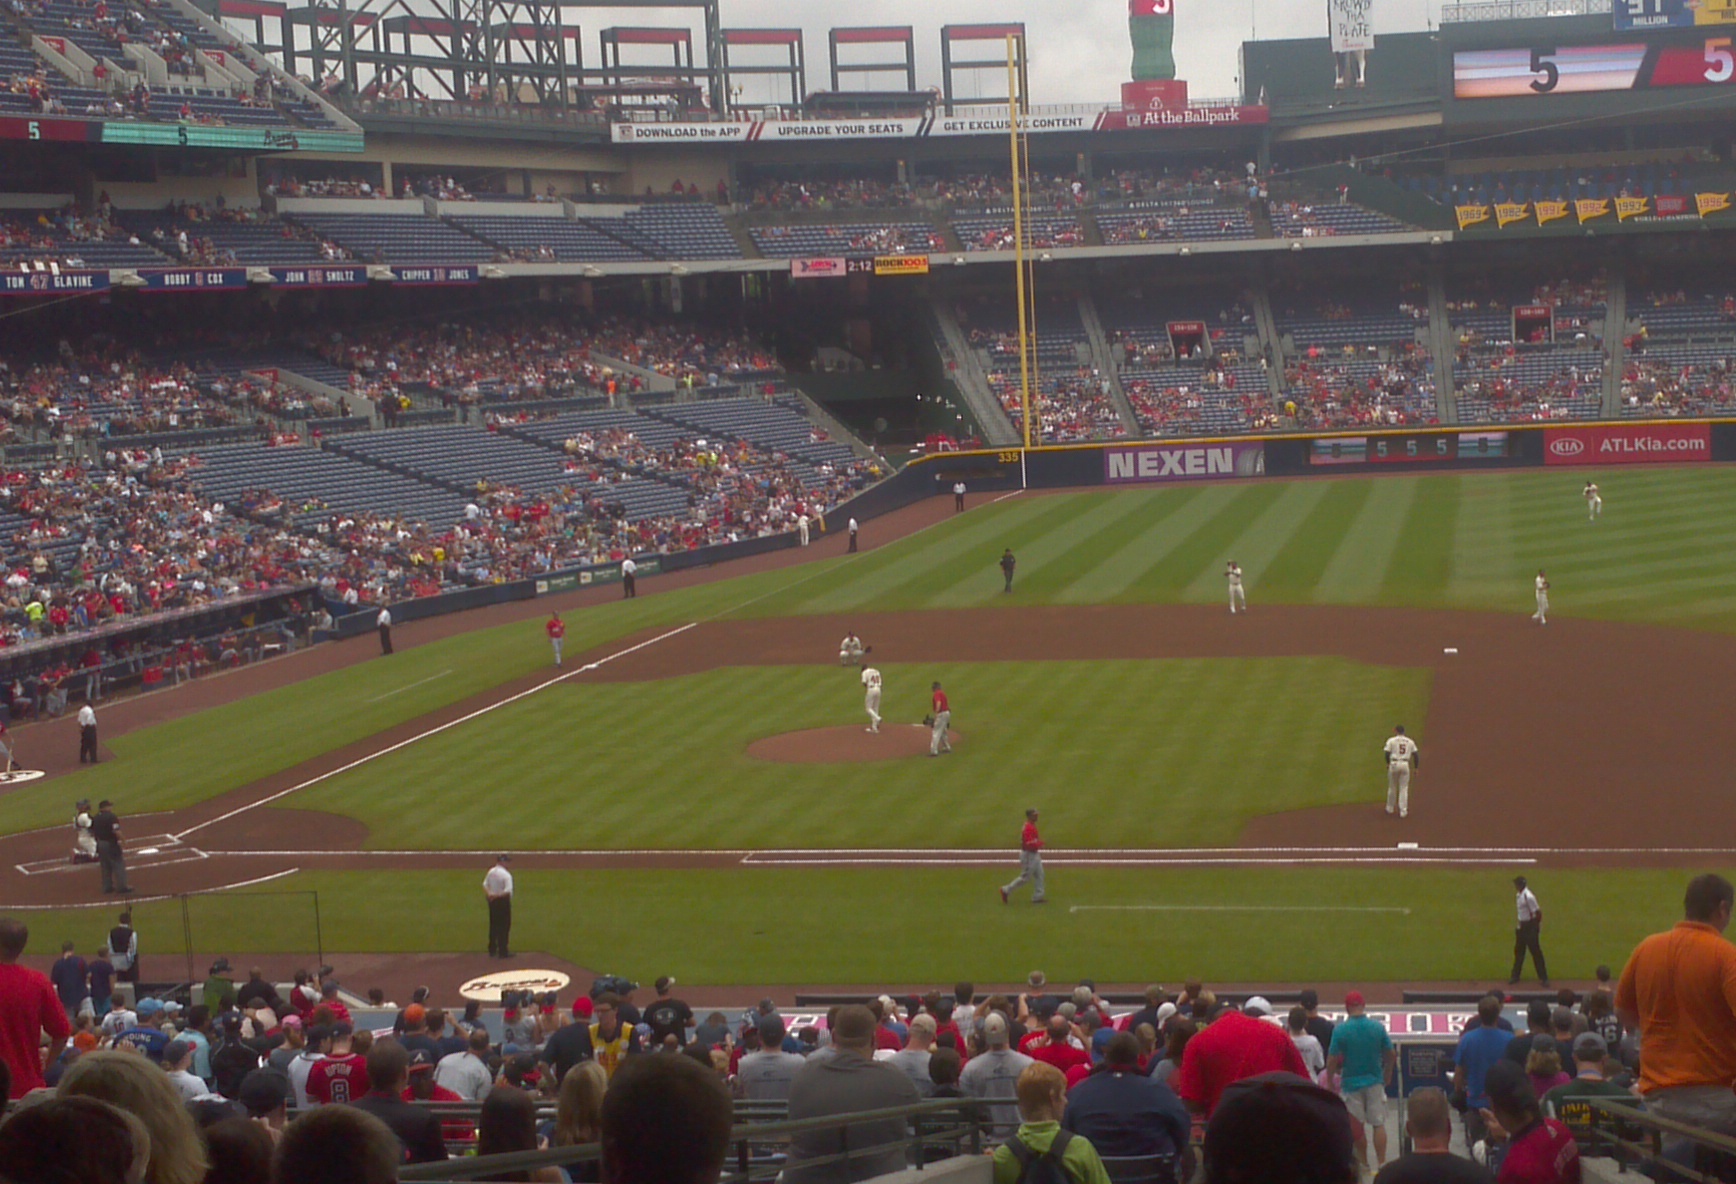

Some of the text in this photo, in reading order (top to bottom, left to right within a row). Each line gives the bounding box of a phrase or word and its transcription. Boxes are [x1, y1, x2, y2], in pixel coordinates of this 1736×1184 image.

[1633, 15, 1668, 26] MILLION
[1339, 22, 1370, 37] PLATE
[1703, 37, 1734, 83] 5
[1529, 48, 1559, 93] 5
[1144, 108, 1240, 125] At the Ballpark
[28, 121, 40, 140] 5
[778, 124, 903, 136] UPGRADE YOUR SEATS
[944, 117, 1083, 131] GET EXCLUSVE CONTENT
[178, 127, 188, 146] 5
[636, 127, 741, 138] DOWNLOAD the APP
[1539, 205, 1560, 217] 1991
[848, 260, 873, 272] 2:12
[6, 274, 93, 290] TOM 47 GLAVINE
[164, 273, 191, 286] BOBBY
[207, 273, 224, 285] COX
[285, 271, 305, 283] JOHN
[326, 270, 355, 282] SMOLTZ
[402, 269, 431, 281] CHIPPER
[449, 269, 469, 280] JONES
[1377, 439, 1447, 457] 5 5 5
[1600, 437, 1705, 452] ATLKia.com
[998, 452, 1019, 463] 335
[1108, 448, 1233, 478] NEXEN
[1399, 744, 1406, 755] 5
[330, 1079, 351, 1104] 8
